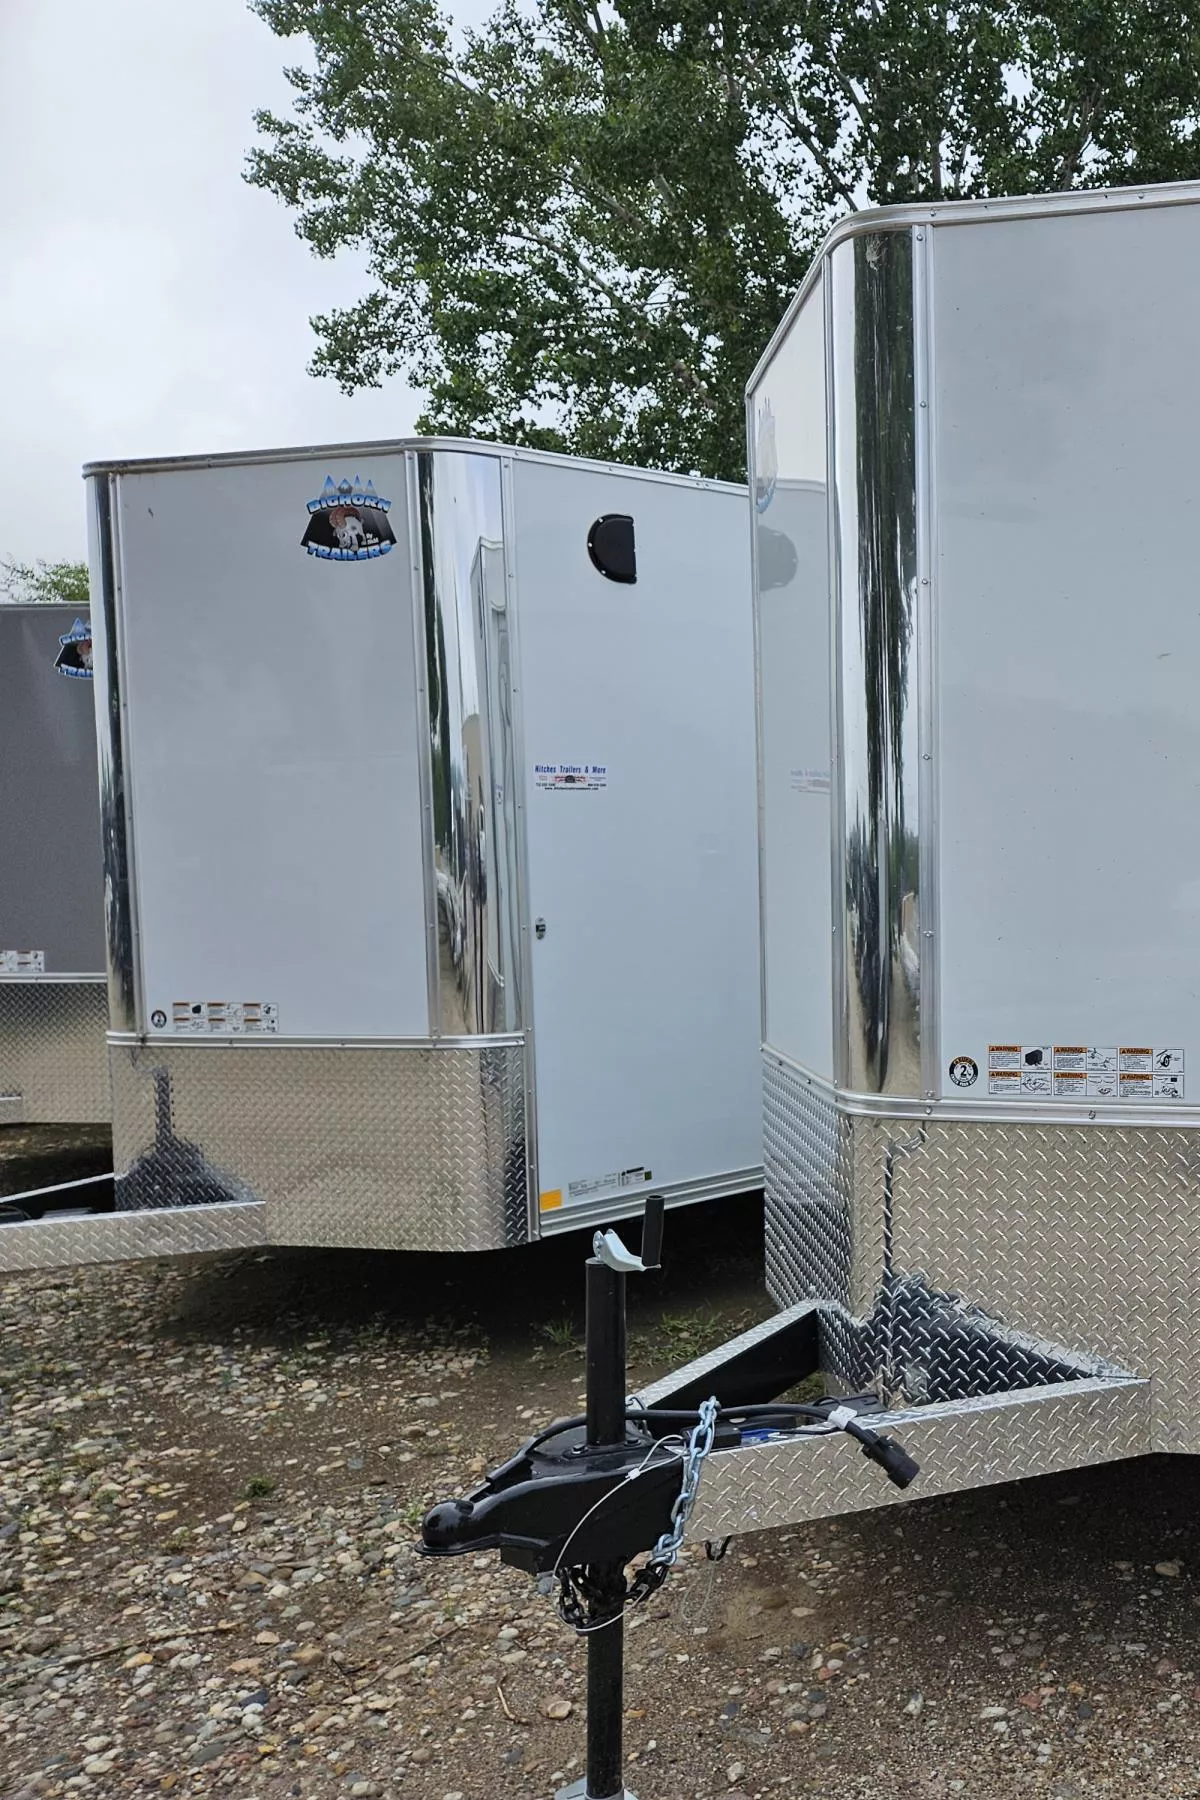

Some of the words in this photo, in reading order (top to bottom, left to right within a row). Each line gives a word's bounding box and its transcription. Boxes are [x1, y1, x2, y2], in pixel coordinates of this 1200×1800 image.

[306, 494, 391, 514] BIGHORN
[307, 540, 392, 561] TRAILERS
[535, 765, 556, 774] Hitches
[560, 765, 581, 774] Trailers
[585, 765, 589, 774] &
[592, 765, 606, 774] More
